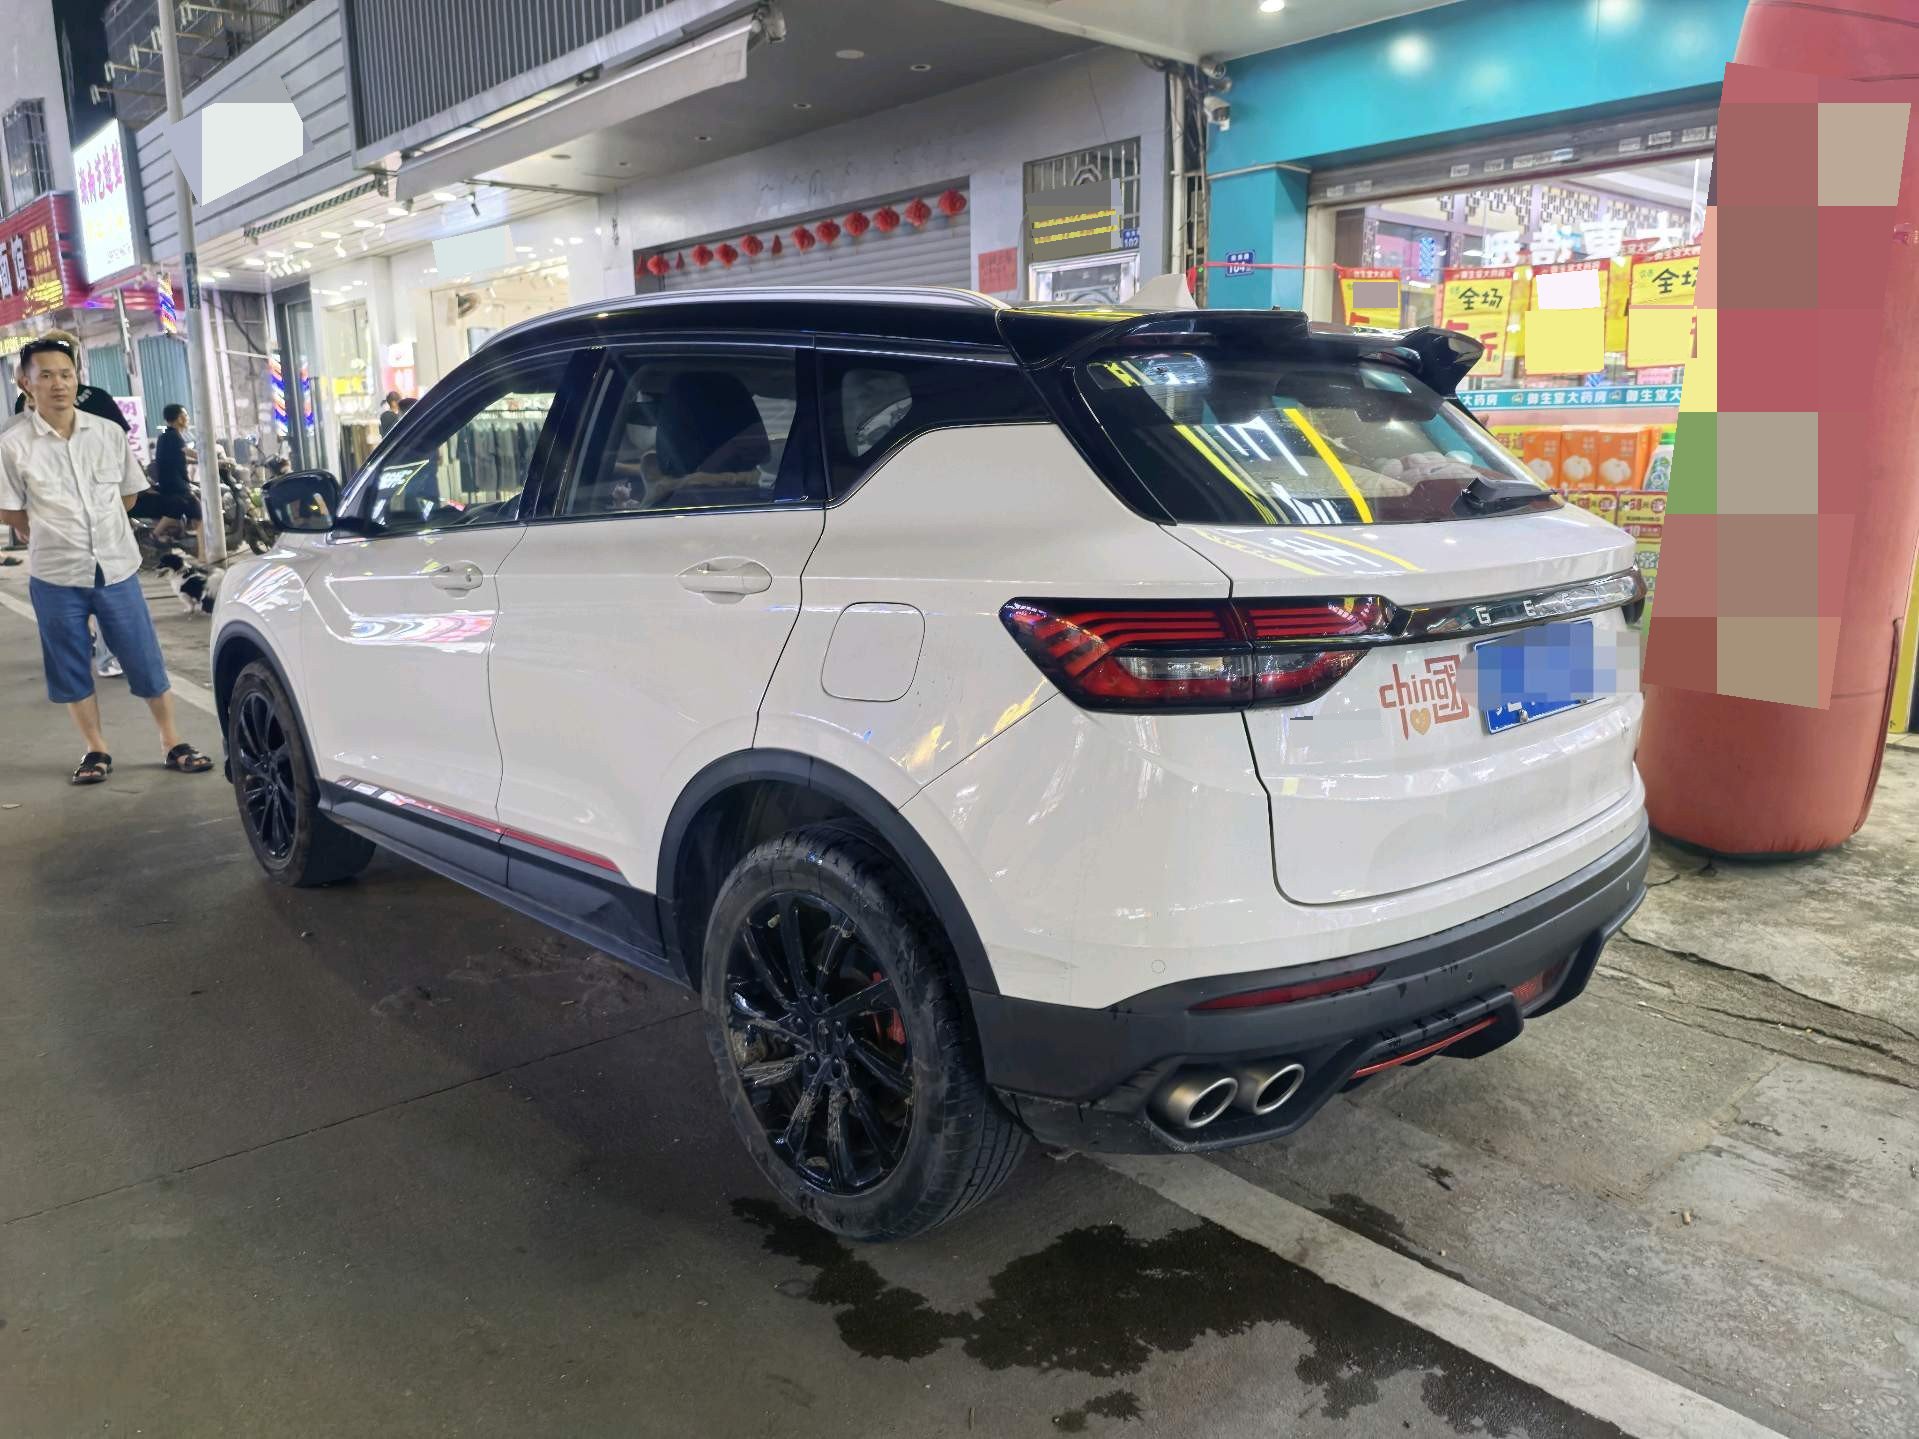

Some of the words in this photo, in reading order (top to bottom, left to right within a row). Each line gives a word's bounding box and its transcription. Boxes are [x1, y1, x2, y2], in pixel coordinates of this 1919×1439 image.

[1459, 287, 1503, 310] 全场
[1459, 393, 1498, 406] 大药房
